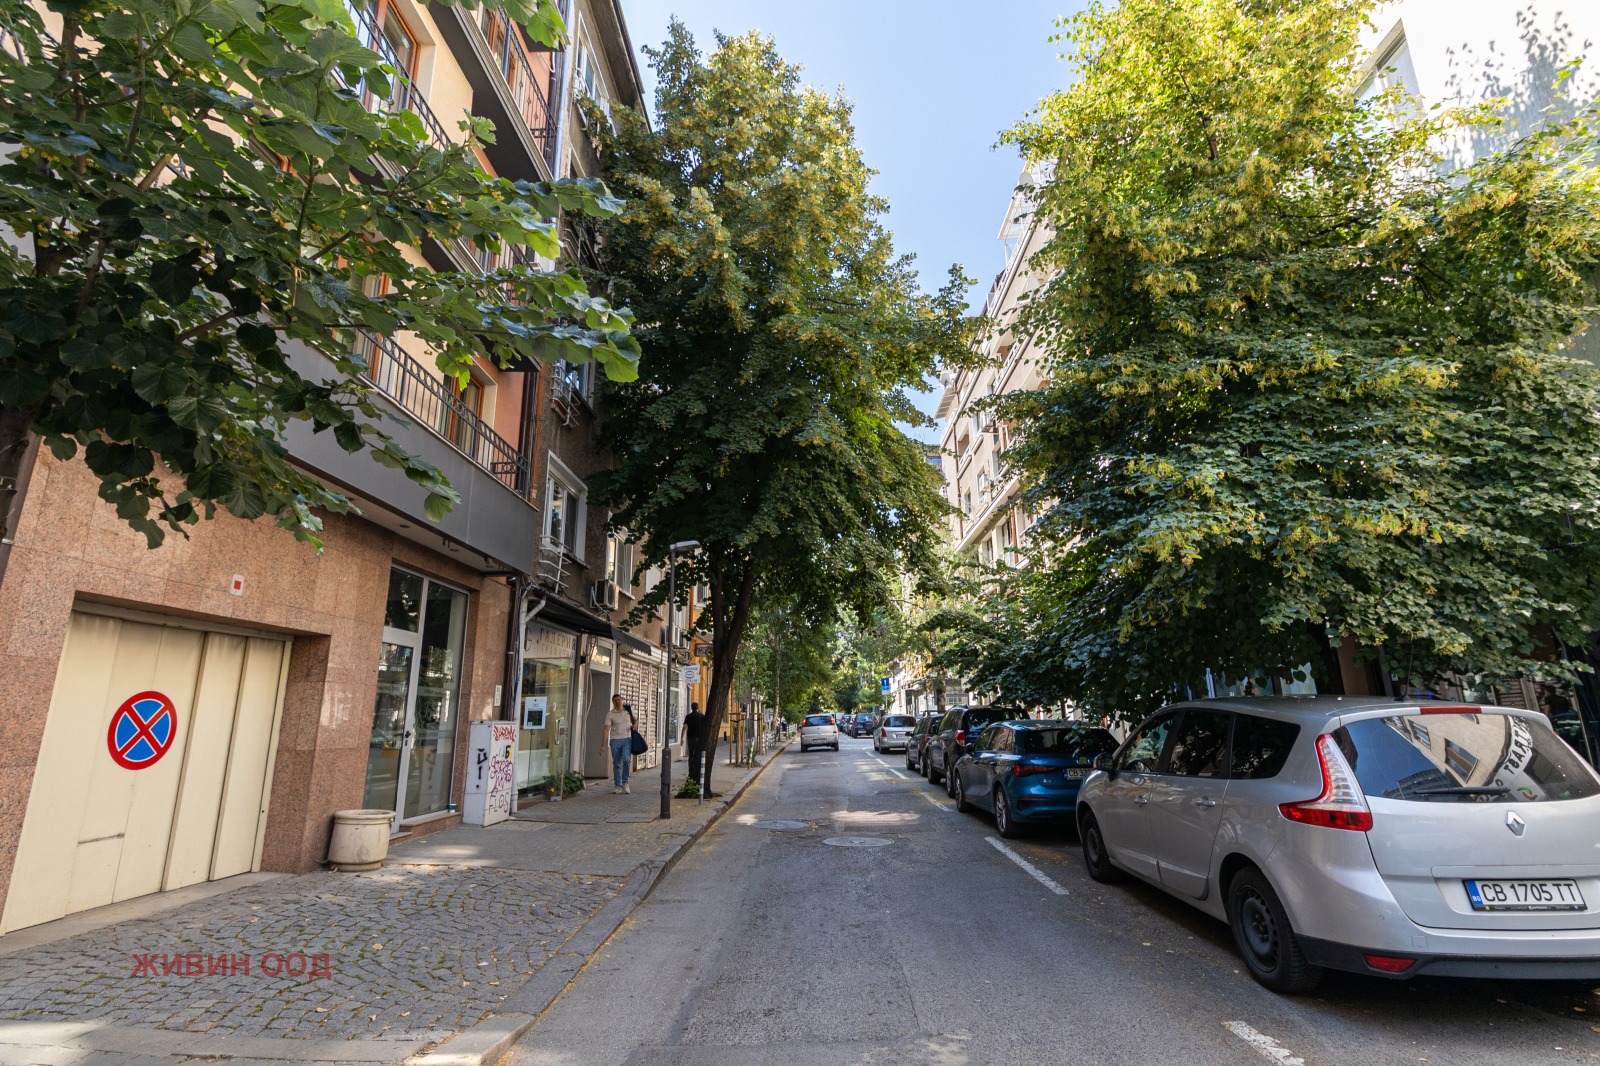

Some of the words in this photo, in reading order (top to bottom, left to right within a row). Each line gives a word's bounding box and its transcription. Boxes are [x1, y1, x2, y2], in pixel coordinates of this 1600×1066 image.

[1480, 883, 1508, 902] CB
[1509, 883, 1553, 902] 1705
[1552, 883, 1577, 902] TT
